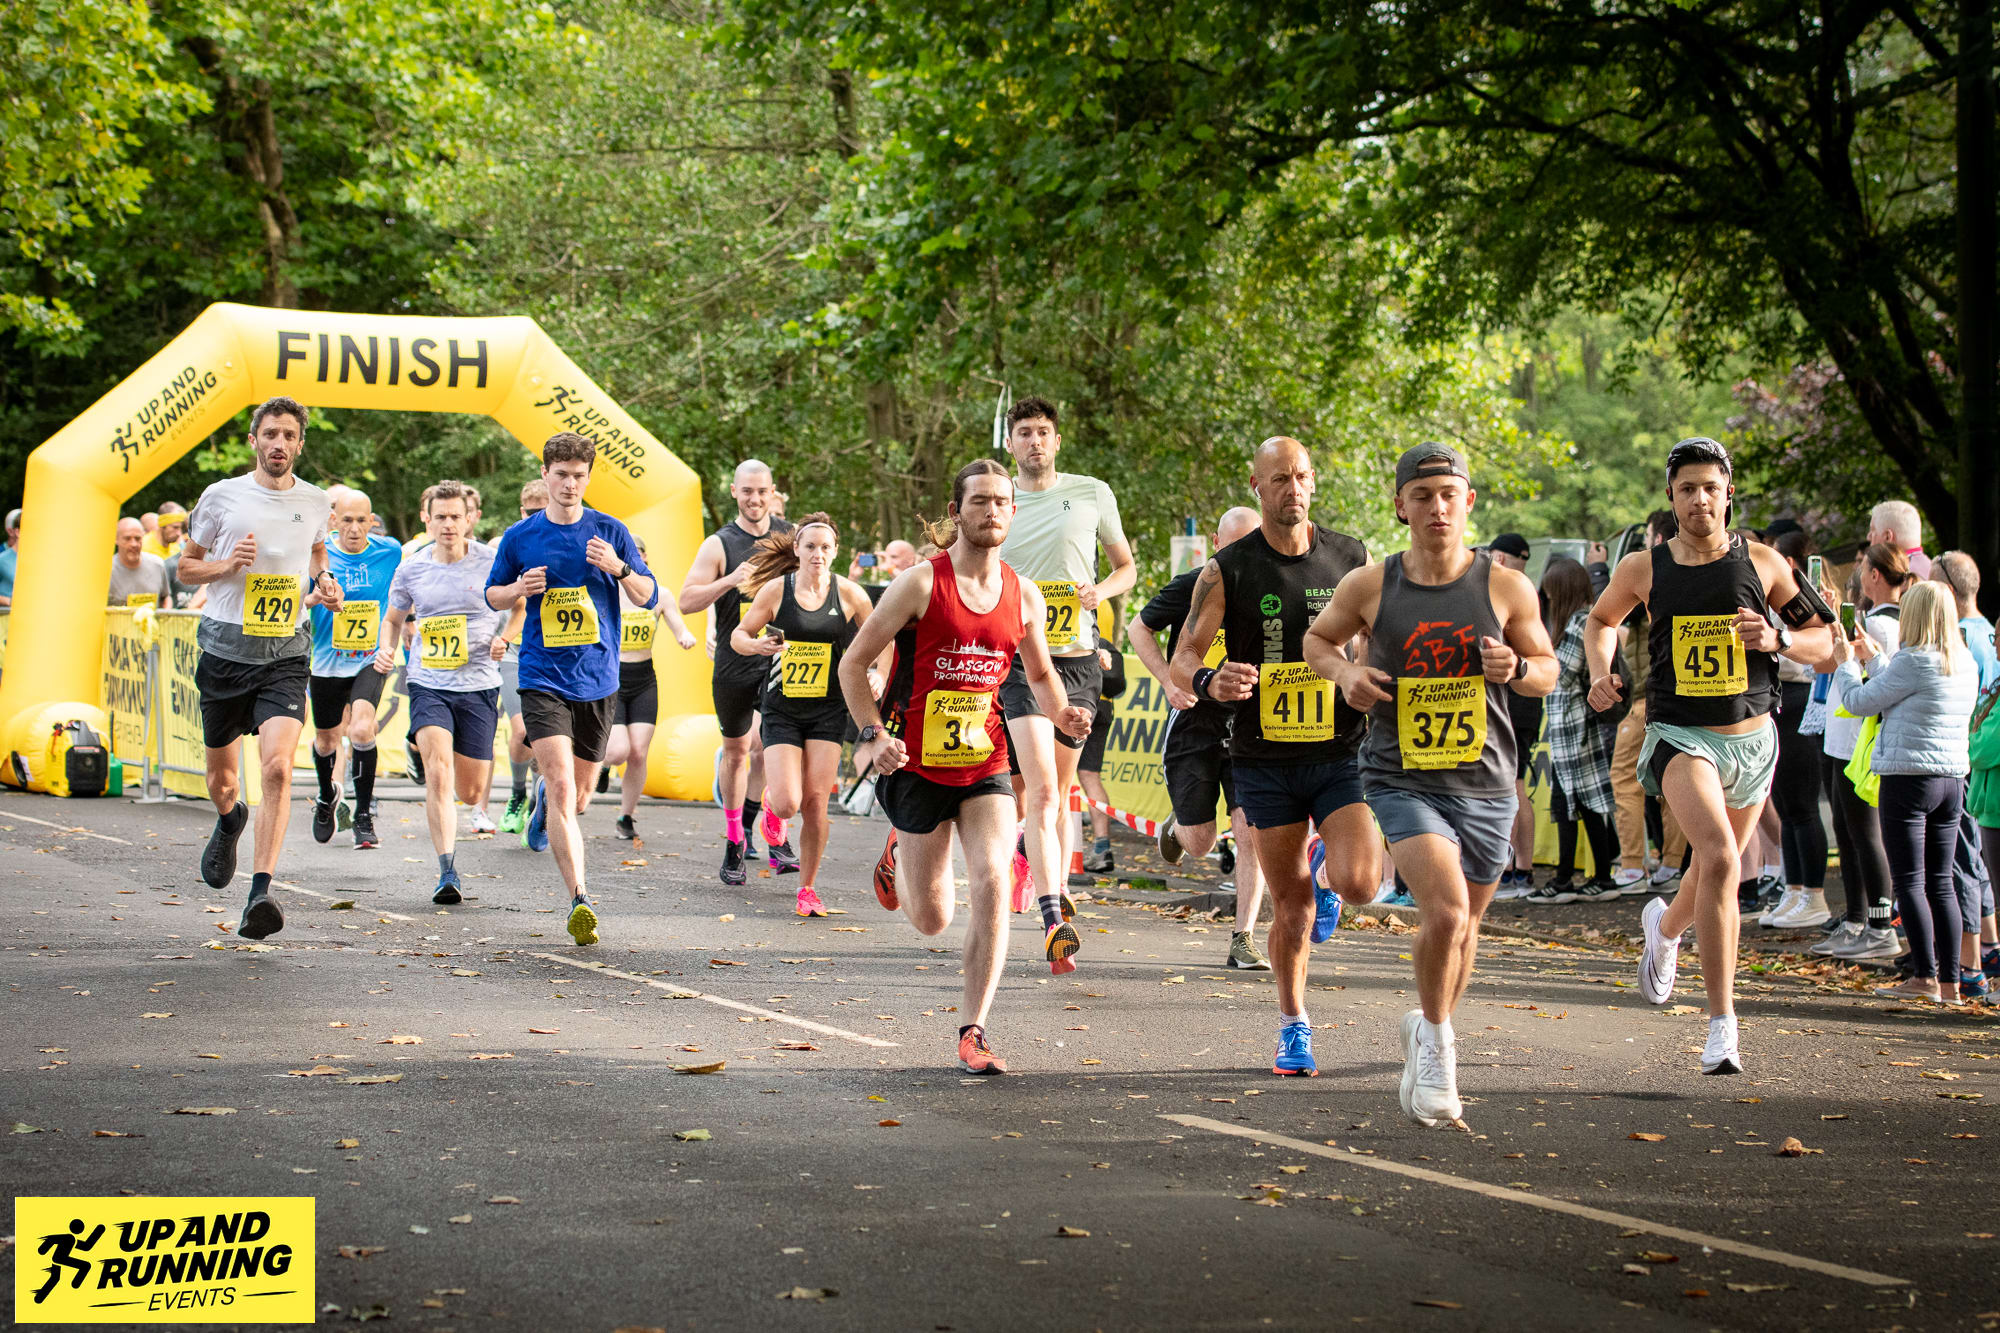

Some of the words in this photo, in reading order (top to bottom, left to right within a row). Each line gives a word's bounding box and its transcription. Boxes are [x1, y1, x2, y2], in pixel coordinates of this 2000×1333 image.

[277, 331, 488, 388] FINISH
[137, 398, 159, 425] UP
[161, 366, 196, 406] AND
[142, 371, 217, 448] RUNNING
[584, 407, 610, 427] UP
[606, 428, 645, 458] AND
[562, 414, 645, 479] RUNNING
[263, 583, 297, 591] RUNNING
[1041, 584, 1053, 592] UP
[1041, 589, 1075, 598] UNNING
[555, 594, 585, 604] RUNNIG
[1306, 601, 1331, 611] Raku
[253, 596, 293, 623] 429
[346, 619, 368, 639] 75
[556, 609, 584, 632] 99
[1698, 621, 1712, 629] UP
[624, 625, 651, 642] 198
[428, 635, 461, 657] 512
[935, 656, 1004, 673] GLASGOW
[1685, 645, 1735, 678] 451
[785, 662, 824, 685] 227
[1288, 668, 1302, 676] UP
[1424, 688, 1477, 703] RUNNING
[1429, 683, 1446, 693] UP
[1446, 680, 1471, 692] AND
[946, 703, 987, 713] RUNNING
[952, 697, 965, 705] UP
[965, 694, 985, 704] AND
[1272, 691, 1323, 723] 411
[1411, 710, 1476, 750] 375
[1403, 750, 1444, 758] Kelvingrove
[1100, 760, 1165, 785] EVENTS
